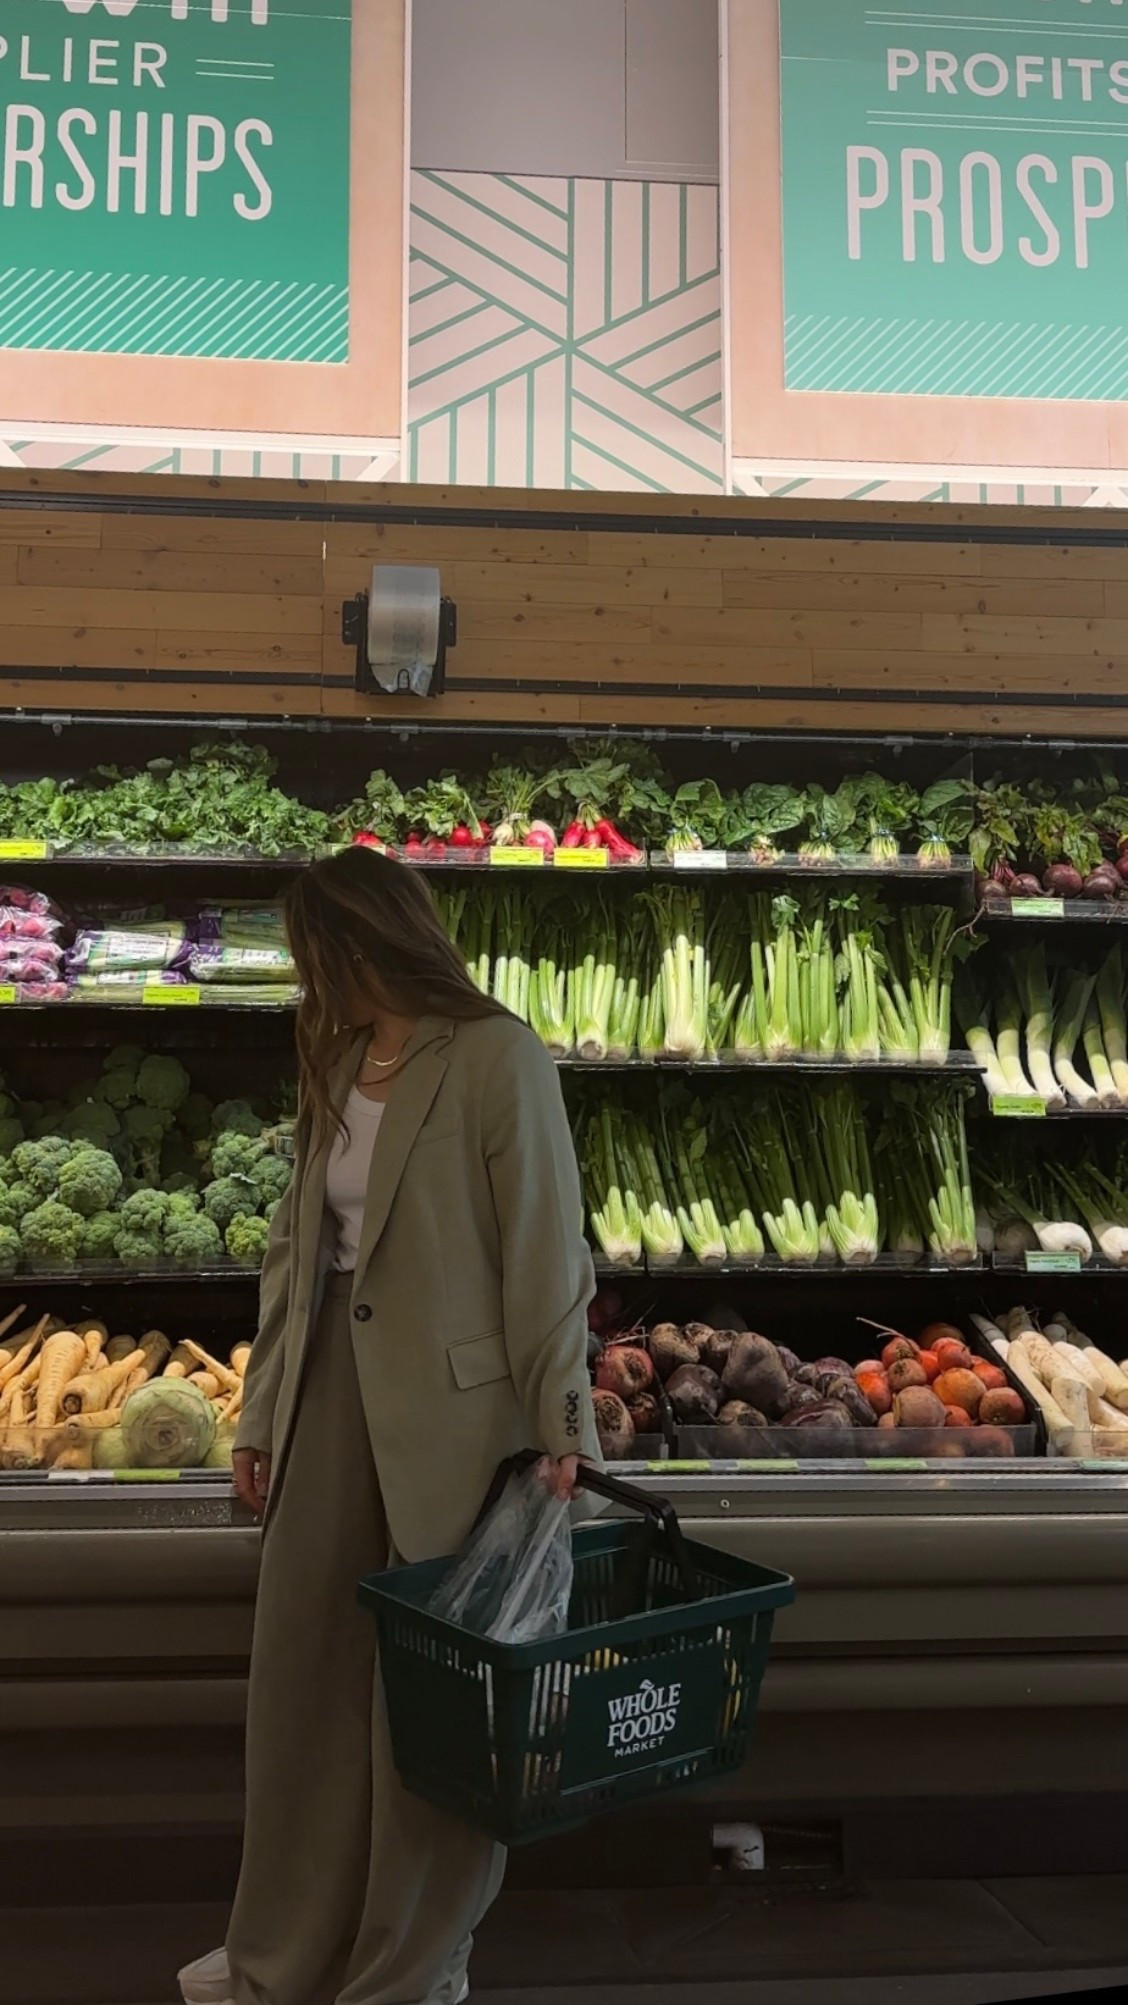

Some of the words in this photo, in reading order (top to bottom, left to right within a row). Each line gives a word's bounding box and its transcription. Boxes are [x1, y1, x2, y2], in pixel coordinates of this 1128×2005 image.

[0, 35, 168, 88] LIER
[886, 48, 1128, 104] PROFITS
[3, 103, 273, 220] RSHIPS
[846, 145, 1128, 269] PROSP
[607, 1708, 677, 1747] FOODS
[608, 1680, 682, 1722] WHOLE
[614, 1736, 665, 1757] MARKET
